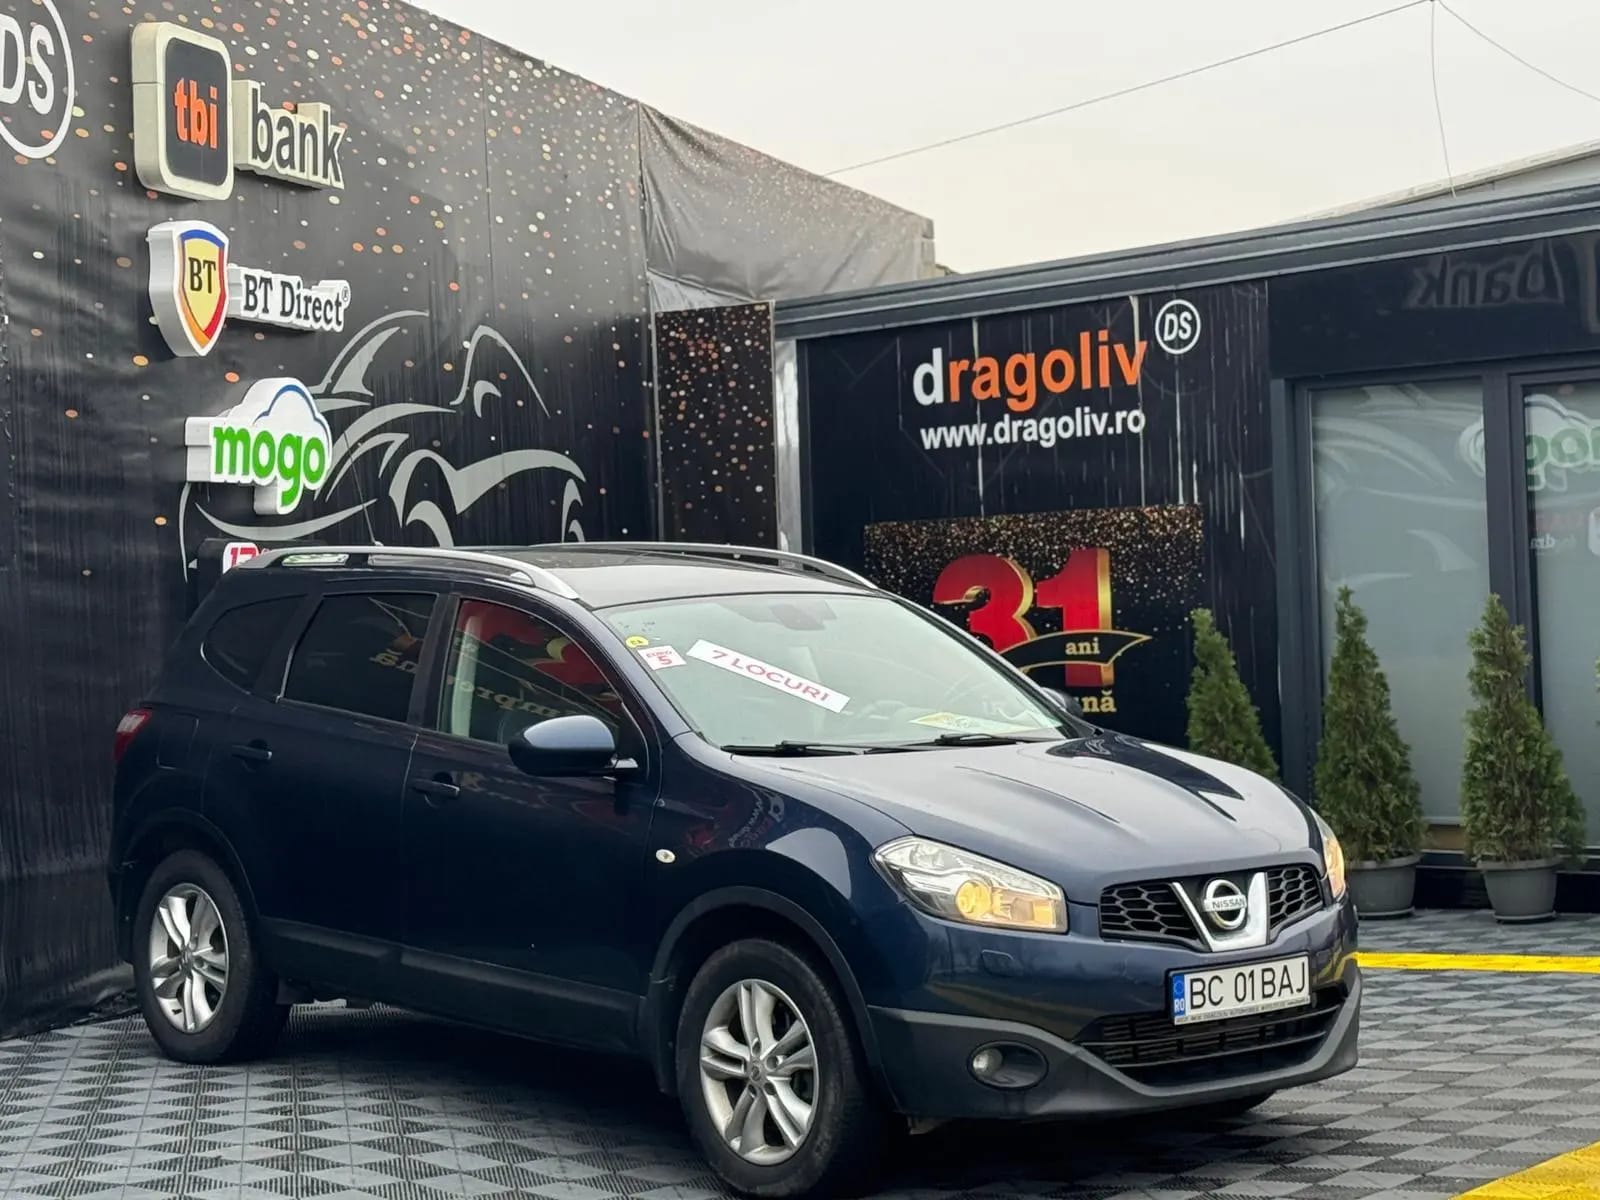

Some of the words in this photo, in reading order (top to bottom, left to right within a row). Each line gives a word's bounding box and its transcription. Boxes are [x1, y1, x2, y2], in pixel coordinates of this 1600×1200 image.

[0, 13, 55, 115] DS
[174, 78, 218, 150] tbi
[251, 86, 342, 184] bank
[188, 257, 216, 294] BT
[243, 273, 273, 314] BT
[1163, 313, 1192, 342] DS
[912, 329, 1147, 412] dragoliv
[920, 406, 1146, 450] www.dragoliv.ro
[213, 426, 326, 507] mogo
[1065, 637, 1101, 655] ani
[711, 649, 726, 660] 7
[730, 657, 829, 701] LOCURI
[1212, 899, 1246, 909] NISSAN
[1190, 975, 1224, 1010] BC
